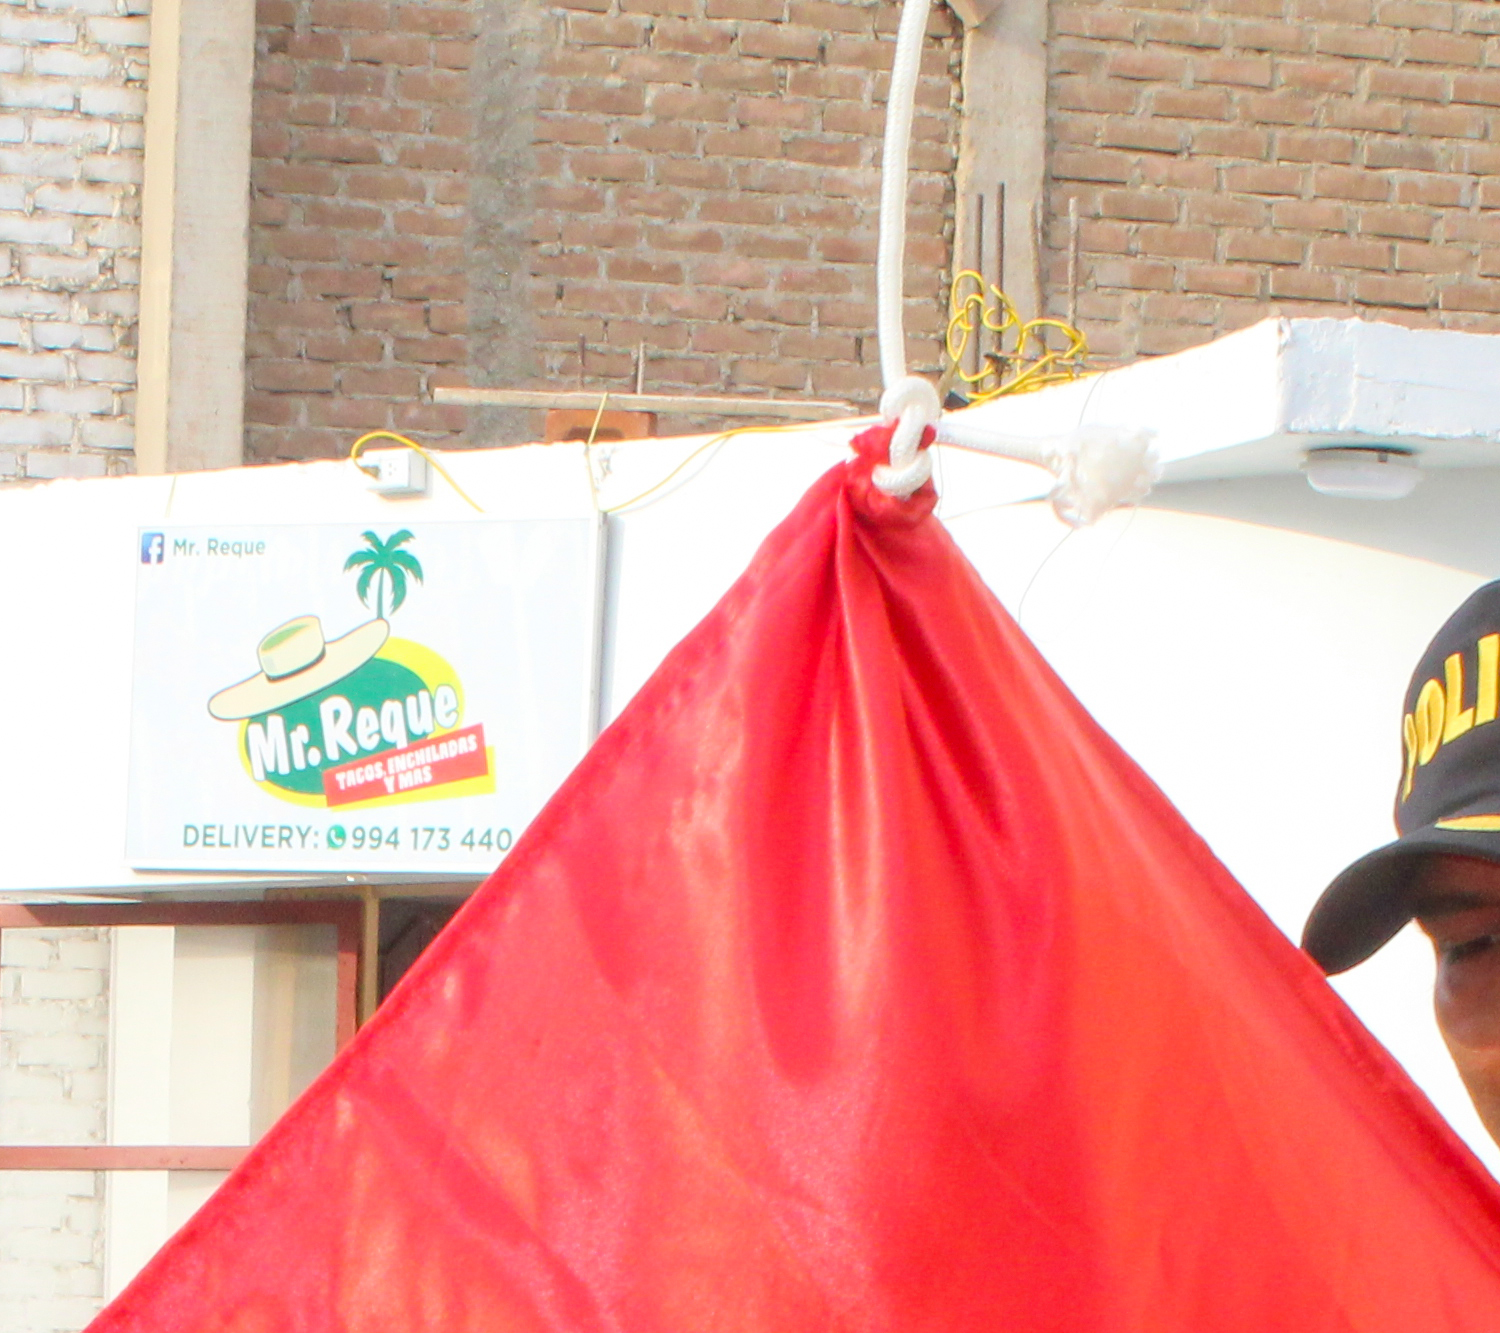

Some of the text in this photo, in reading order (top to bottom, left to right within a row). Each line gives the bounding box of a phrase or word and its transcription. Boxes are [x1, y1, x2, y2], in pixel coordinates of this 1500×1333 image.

[172, 537, 267, 559] Mr. Reque
[246, 683, 460, 783] Mr. Reque
[334, 733, 478, 791] TACOS, ENCHILADAS
[383, 764, 433, 794] Y MAS
[182, 823, 514, 852] DELIVERY: 994 173 440
